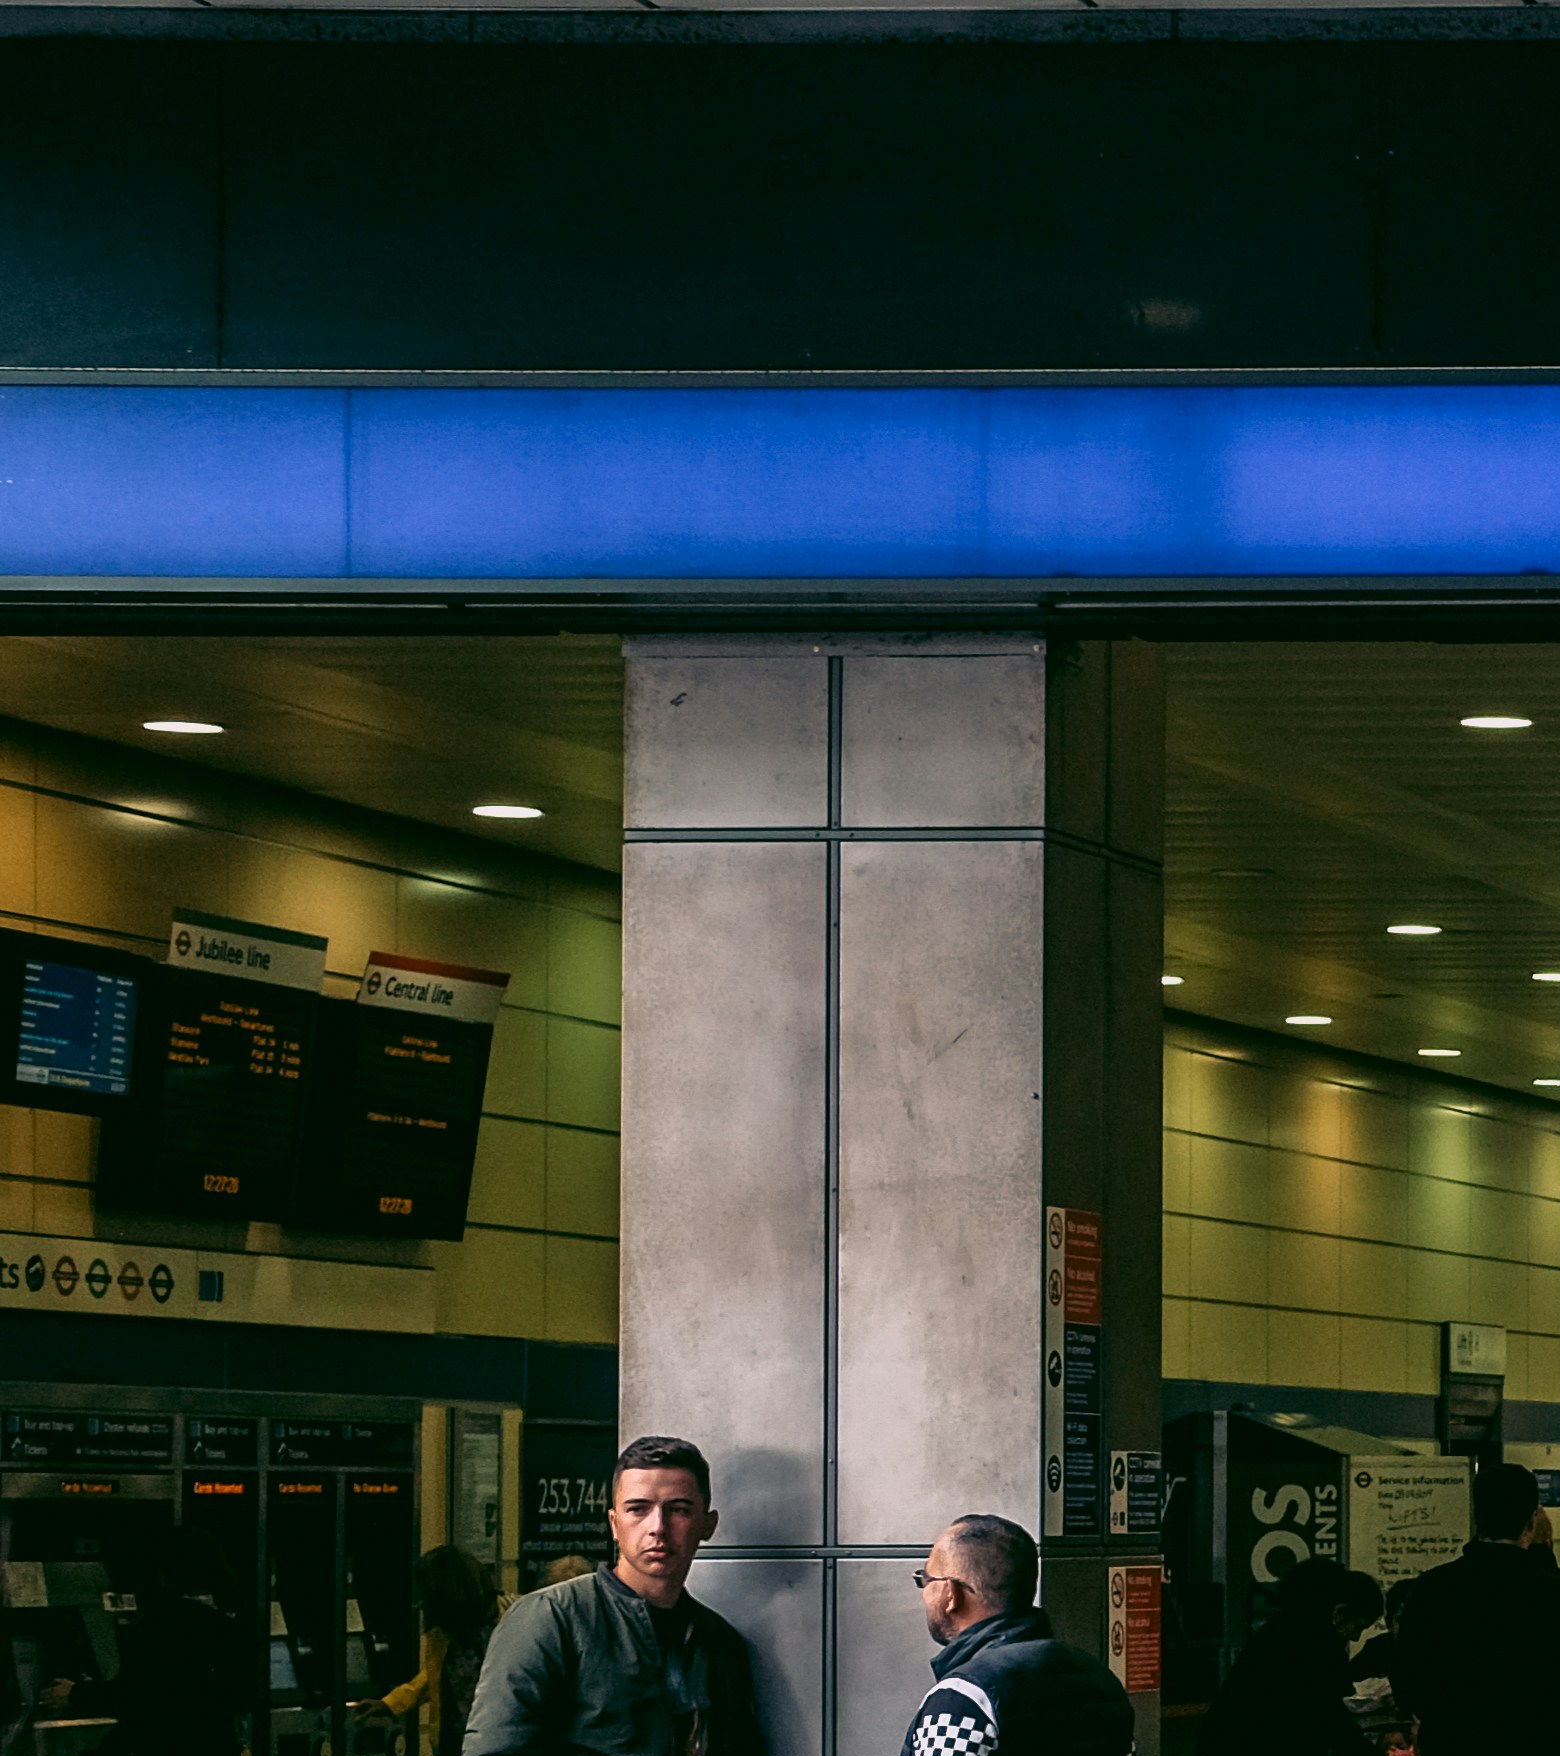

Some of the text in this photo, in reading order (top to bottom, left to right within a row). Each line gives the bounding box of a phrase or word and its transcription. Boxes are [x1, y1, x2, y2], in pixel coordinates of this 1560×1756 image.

[196, 936, 272, 971] Jubilee line
[384, 976, 455, 1006] Central line
[538, 1477, 608, 1517] 253,744
[1378, 1475, 1464, 1485] Service information
[1314, 1484, 1338, 1561] ENTS
